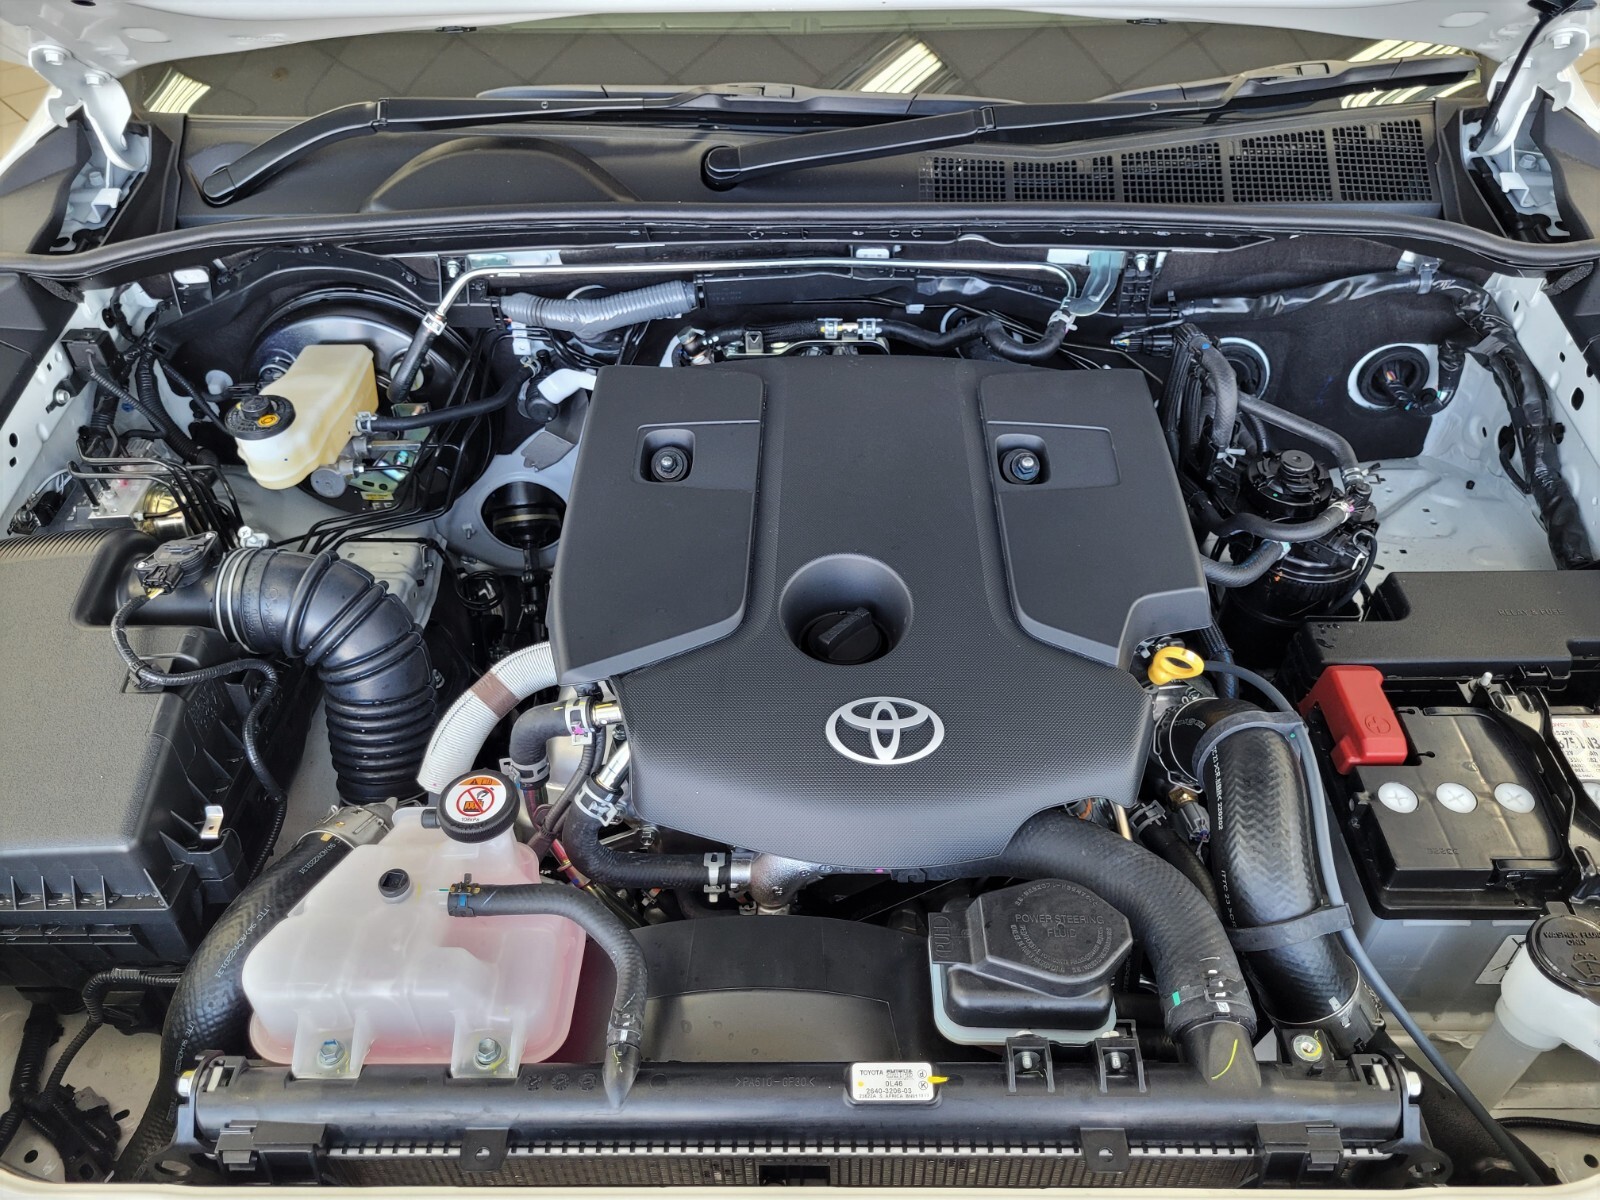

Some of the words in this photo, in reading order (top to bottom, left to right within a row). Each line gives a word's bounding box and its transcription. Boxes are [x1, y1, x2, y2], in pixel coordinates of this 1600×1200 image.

[1497, 608, 1528, 617] RELAY
[1539, 608, 1566, 616] FUSE
[1014, 913, 1053, 923] POWER
[1054, 914, 1105, 925] STEERING
[1046, 927, 1077, 938] FLUID
[1543, 931, 1579, 939] WASHER
